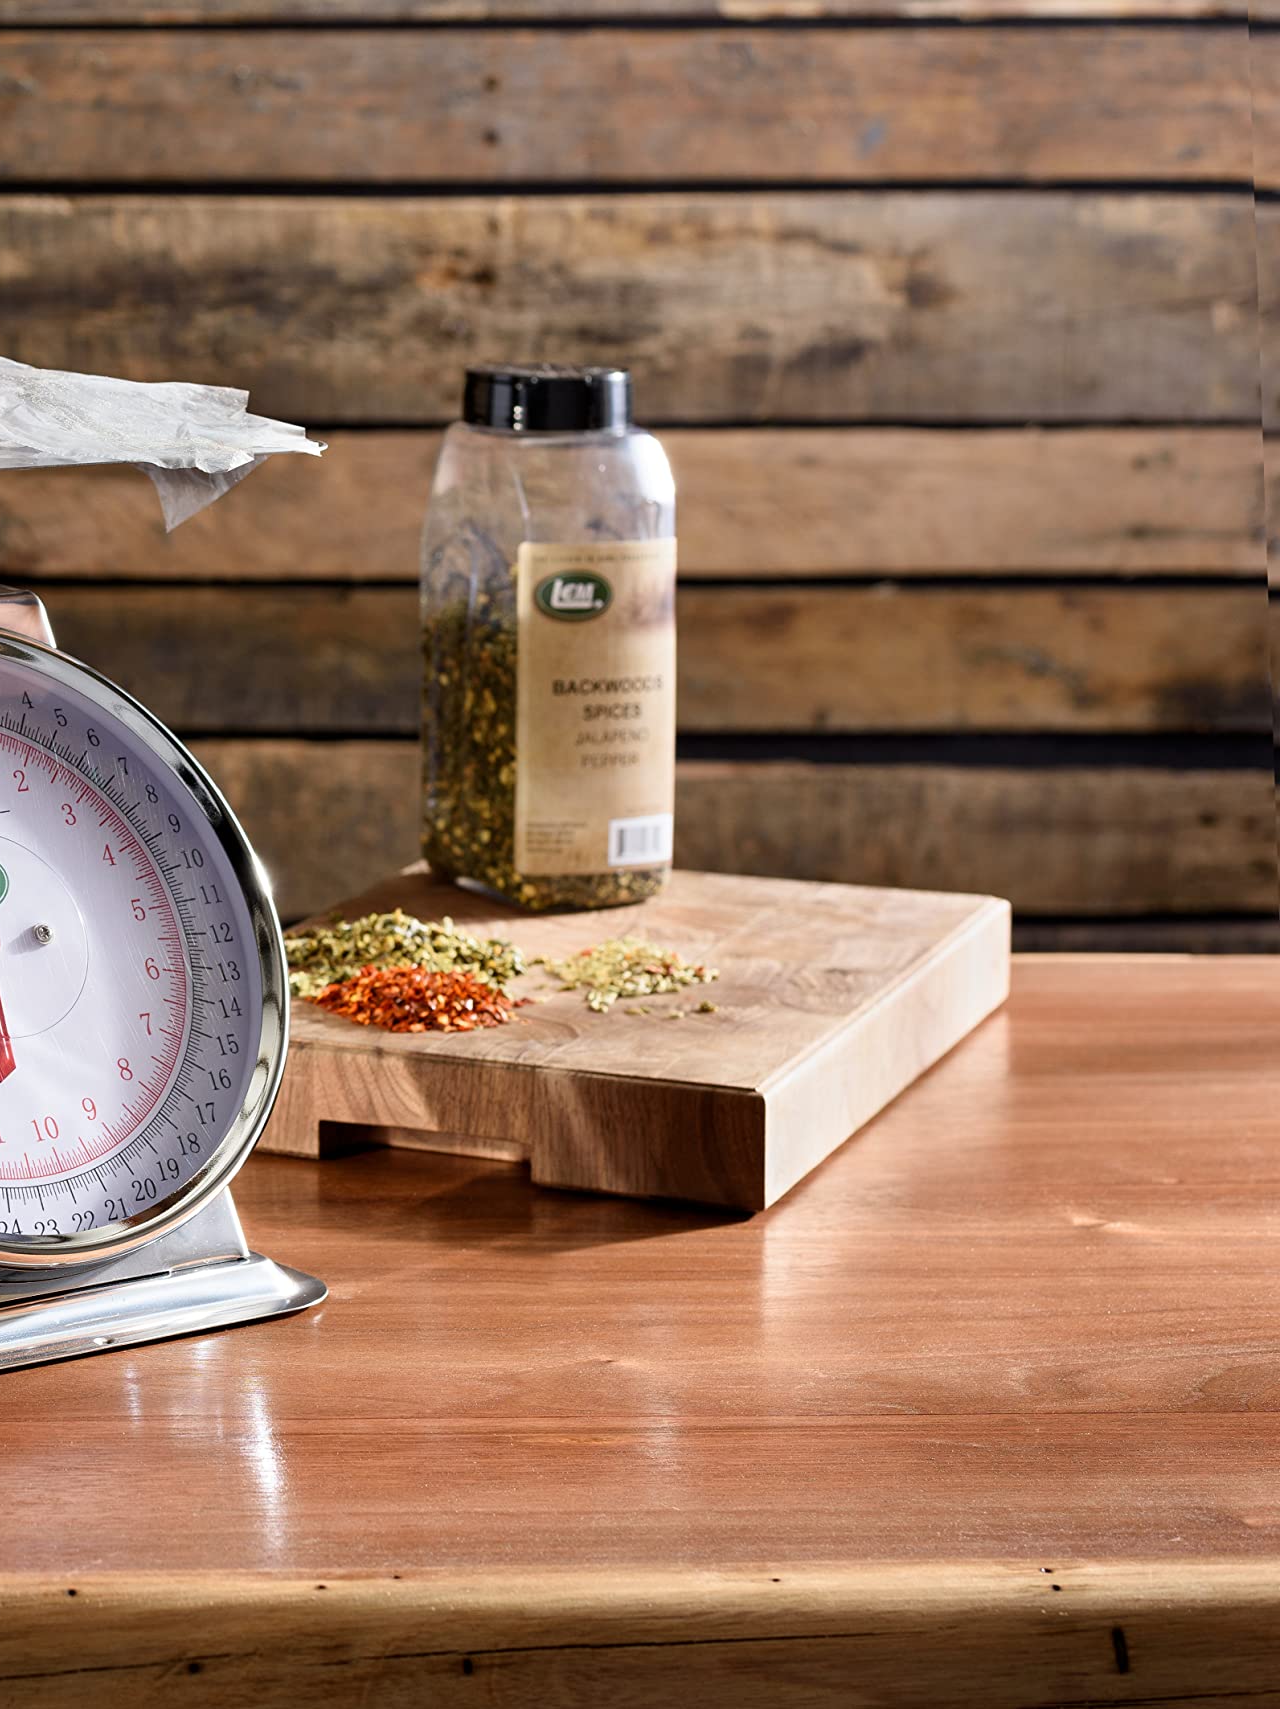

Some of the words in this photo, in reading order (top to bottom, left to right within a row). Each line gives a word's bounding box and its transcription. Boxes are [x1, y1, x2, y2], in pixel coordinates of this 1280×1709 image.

[552, 674, 663, 696] BACKWOODS
[21, 691, 34, 709] 4
[53, 708, 67, 727] 5
[583, 703, 642, 721] SPICES
[87, 728, 100, 747] 6
[117, 757, 129, 775] 7
[13, 769, 29, 792] 2
[145, 784, 159, 804] 8
[61, 803, 77, 826] 3
[168, 814, 181, 833] 9
[102, 844, 117, 866] 4
[181, 848, 204, 869] 10
[199, 884, 223, 905] 11
[131, 898, 146, 921] 5
[210, 922, 234, 944] 12
[144, 957, 160, 980] 6
[217, 960, 241, 983] 13
[219, 997, 242, 1019] 14
[139, 1012, 152, 1036] 7
[216, 1033, 239, 1056] 15
[117, 1058, 133, 1081] 8
[207, 1068, 232, 1091] 16
[81, 1097, 97, 1120] 9
[195, 1102, 216, 1125] 17
[31, 1116, 60, 1142] 10
[177, 1132, 201, 1156] 18
[156, 1158, 180, 1182] 19
[132, 1178, 157, 1202] 20
[72, 1210, 98, 1232] 22
[104, 1198, 130, 1221] 21
[34, 1219, 61, 1236] 23
